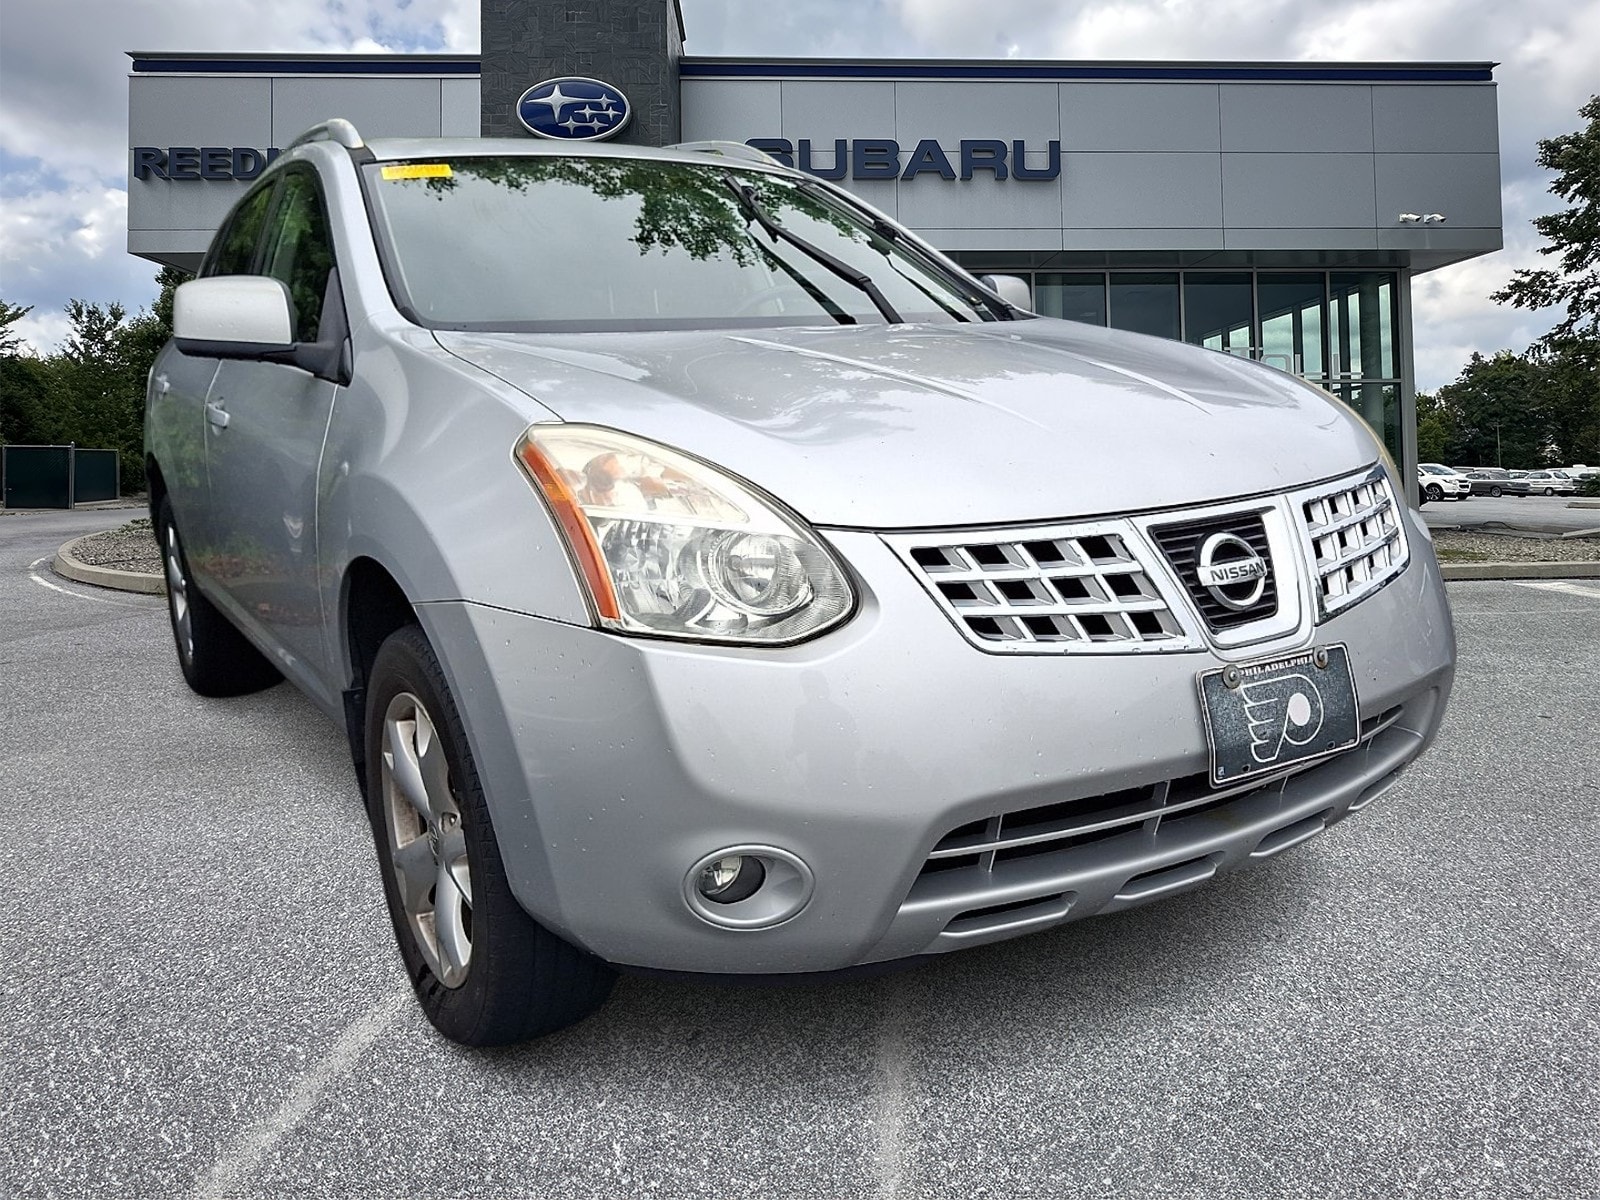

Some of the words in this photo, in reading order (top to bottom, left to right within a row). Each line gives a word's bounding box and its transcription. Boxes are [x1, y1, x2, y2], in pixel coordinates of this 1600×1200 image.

[133, 147, 281, 181] REED
[745, 139, 1061, 181] SUBARU
[1210, 562, 1265, 582] NISSAN
